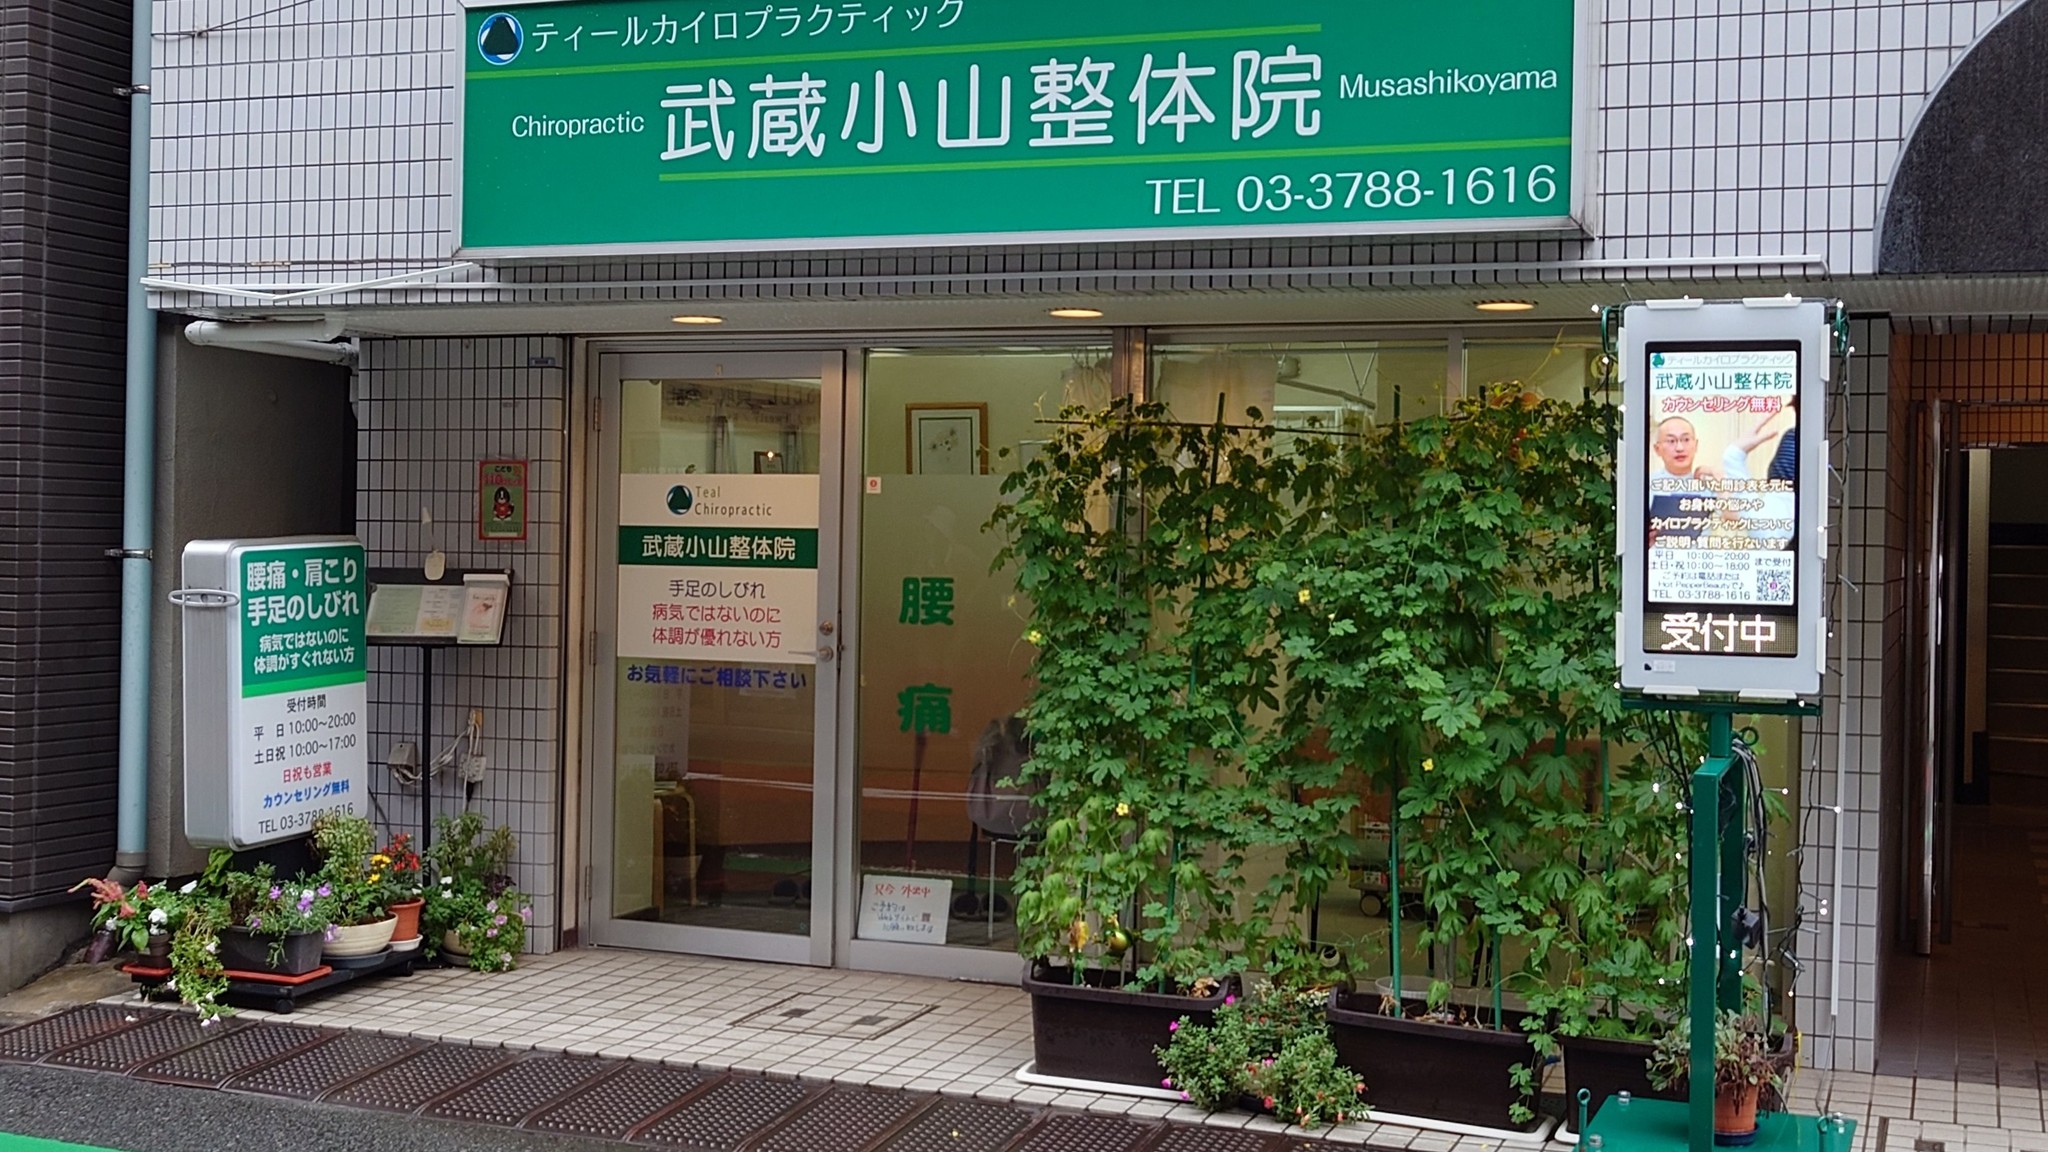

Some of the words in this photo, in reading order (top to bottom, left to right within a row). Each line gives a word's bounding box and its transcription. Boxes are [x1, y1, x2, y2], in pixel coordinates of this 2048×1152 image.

[531, 0, 964, 52] ティールカイロプラクティック
[511, 111, 645, 138] Chiropractic
[660, 45, 1322, 160] 武蔵小山整体院
[1340, 68, 1557, 100] Musashikoyama
[1145, 178, 1220, 215] TEL
[1236, 164, 1557, 211] 03-3788-1616
[1667, 353, 1794, 366] ティールカイロプラクティック
[1655, 371, 1792, 390] 武蔵小山整体院
[1662, 395, 1782, 412] カウンセリング無料
[695, 486, 721, 498] Teal
[694, 502, 772, 517] Chiropractic
[1679, 498, 1764, 511] お身体の悩みや
[1650, 517, 1792, 530] カイロプラクティックについて
[642, 535, 796, 560] 武蔵小山整体院
[1655, 550, 1674, 559] 平日
[1755, 557, 1791, 567] まで受付
[247, 557, 358, 591] 腰痛・肩こり
[668, 579, 766, 599] 手足のしびれ
[1652, 589, 1672, 599] TEL
[1678, 590, 1751, 600] 03-3788-1616
[247, 590, 359, 626] 手足のしびれ
[652, 603, 781, 623] 病気ではないのに
[259, 628, 349, 652] 病気ではないのに
[652, 627, 782, 649] 体調が優れない方
[1661, 612, 1776, 653] 受付中
[254, 646, 355, 674] 体調がすぐれない方
[627, 664, 806, 689] お気軽にご相談下さい
[287, 693, 327, 713] 受付時間
[254, 746, 286, 765] 土日祝
[283, 761, 332, 783] 日祝も営業
[263, 779, 350, 809] カウンセリング無料
[258, 819, 278, 834] TEL
